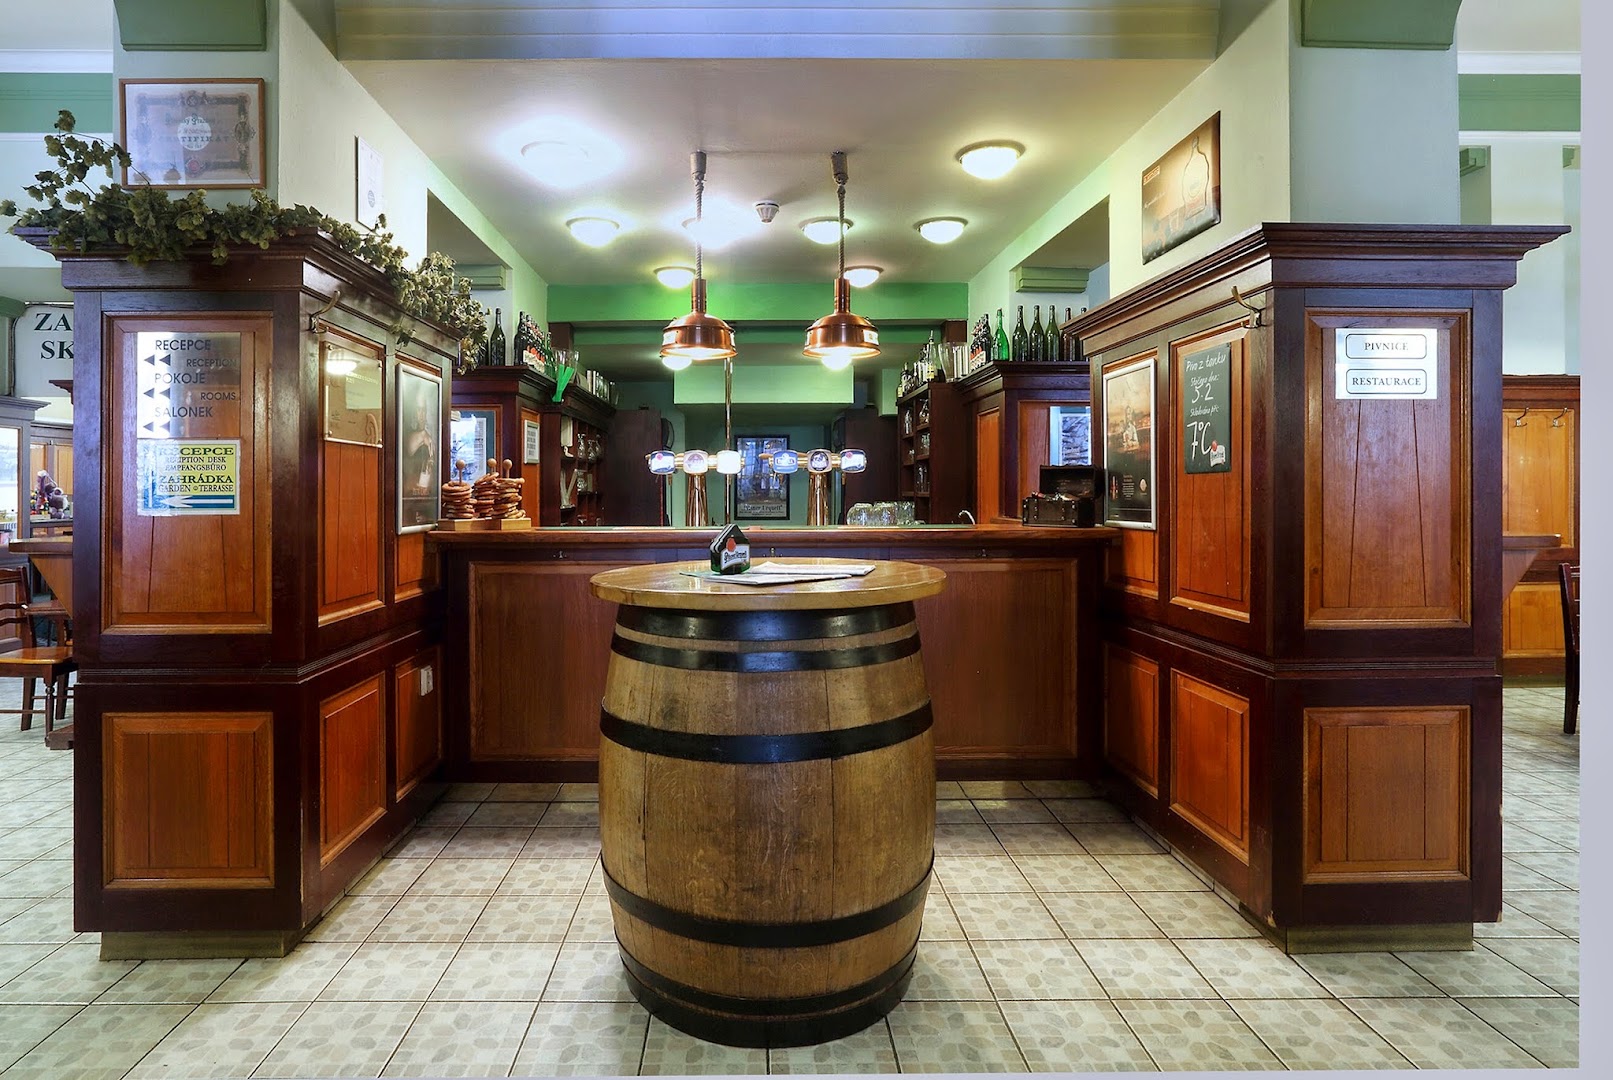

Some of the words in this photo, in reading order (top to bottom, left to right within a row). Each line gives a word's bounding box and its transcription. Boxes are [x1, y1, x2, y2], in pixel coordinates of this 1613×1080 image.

[155, 339, 211, 351] RECEPCE
[1364, 342, 1409, 351] PIVNICE
[186, 358, 237, 367] RECEPTION
[154, 372, 206, 384] POKOJE
[1352, 377, 1421, 386] RESTAURACE
[200, 392, 236, 401] ROOMS
[155, 406, 213, 418] SALONEK
[160, 447, 234, 455] RECEPCE
[159, 473, 234, 484] ZAHRÁDKA
[158, 484, 191, 492] GARDEN
[199, 484, 234, 492] TERRASSE
